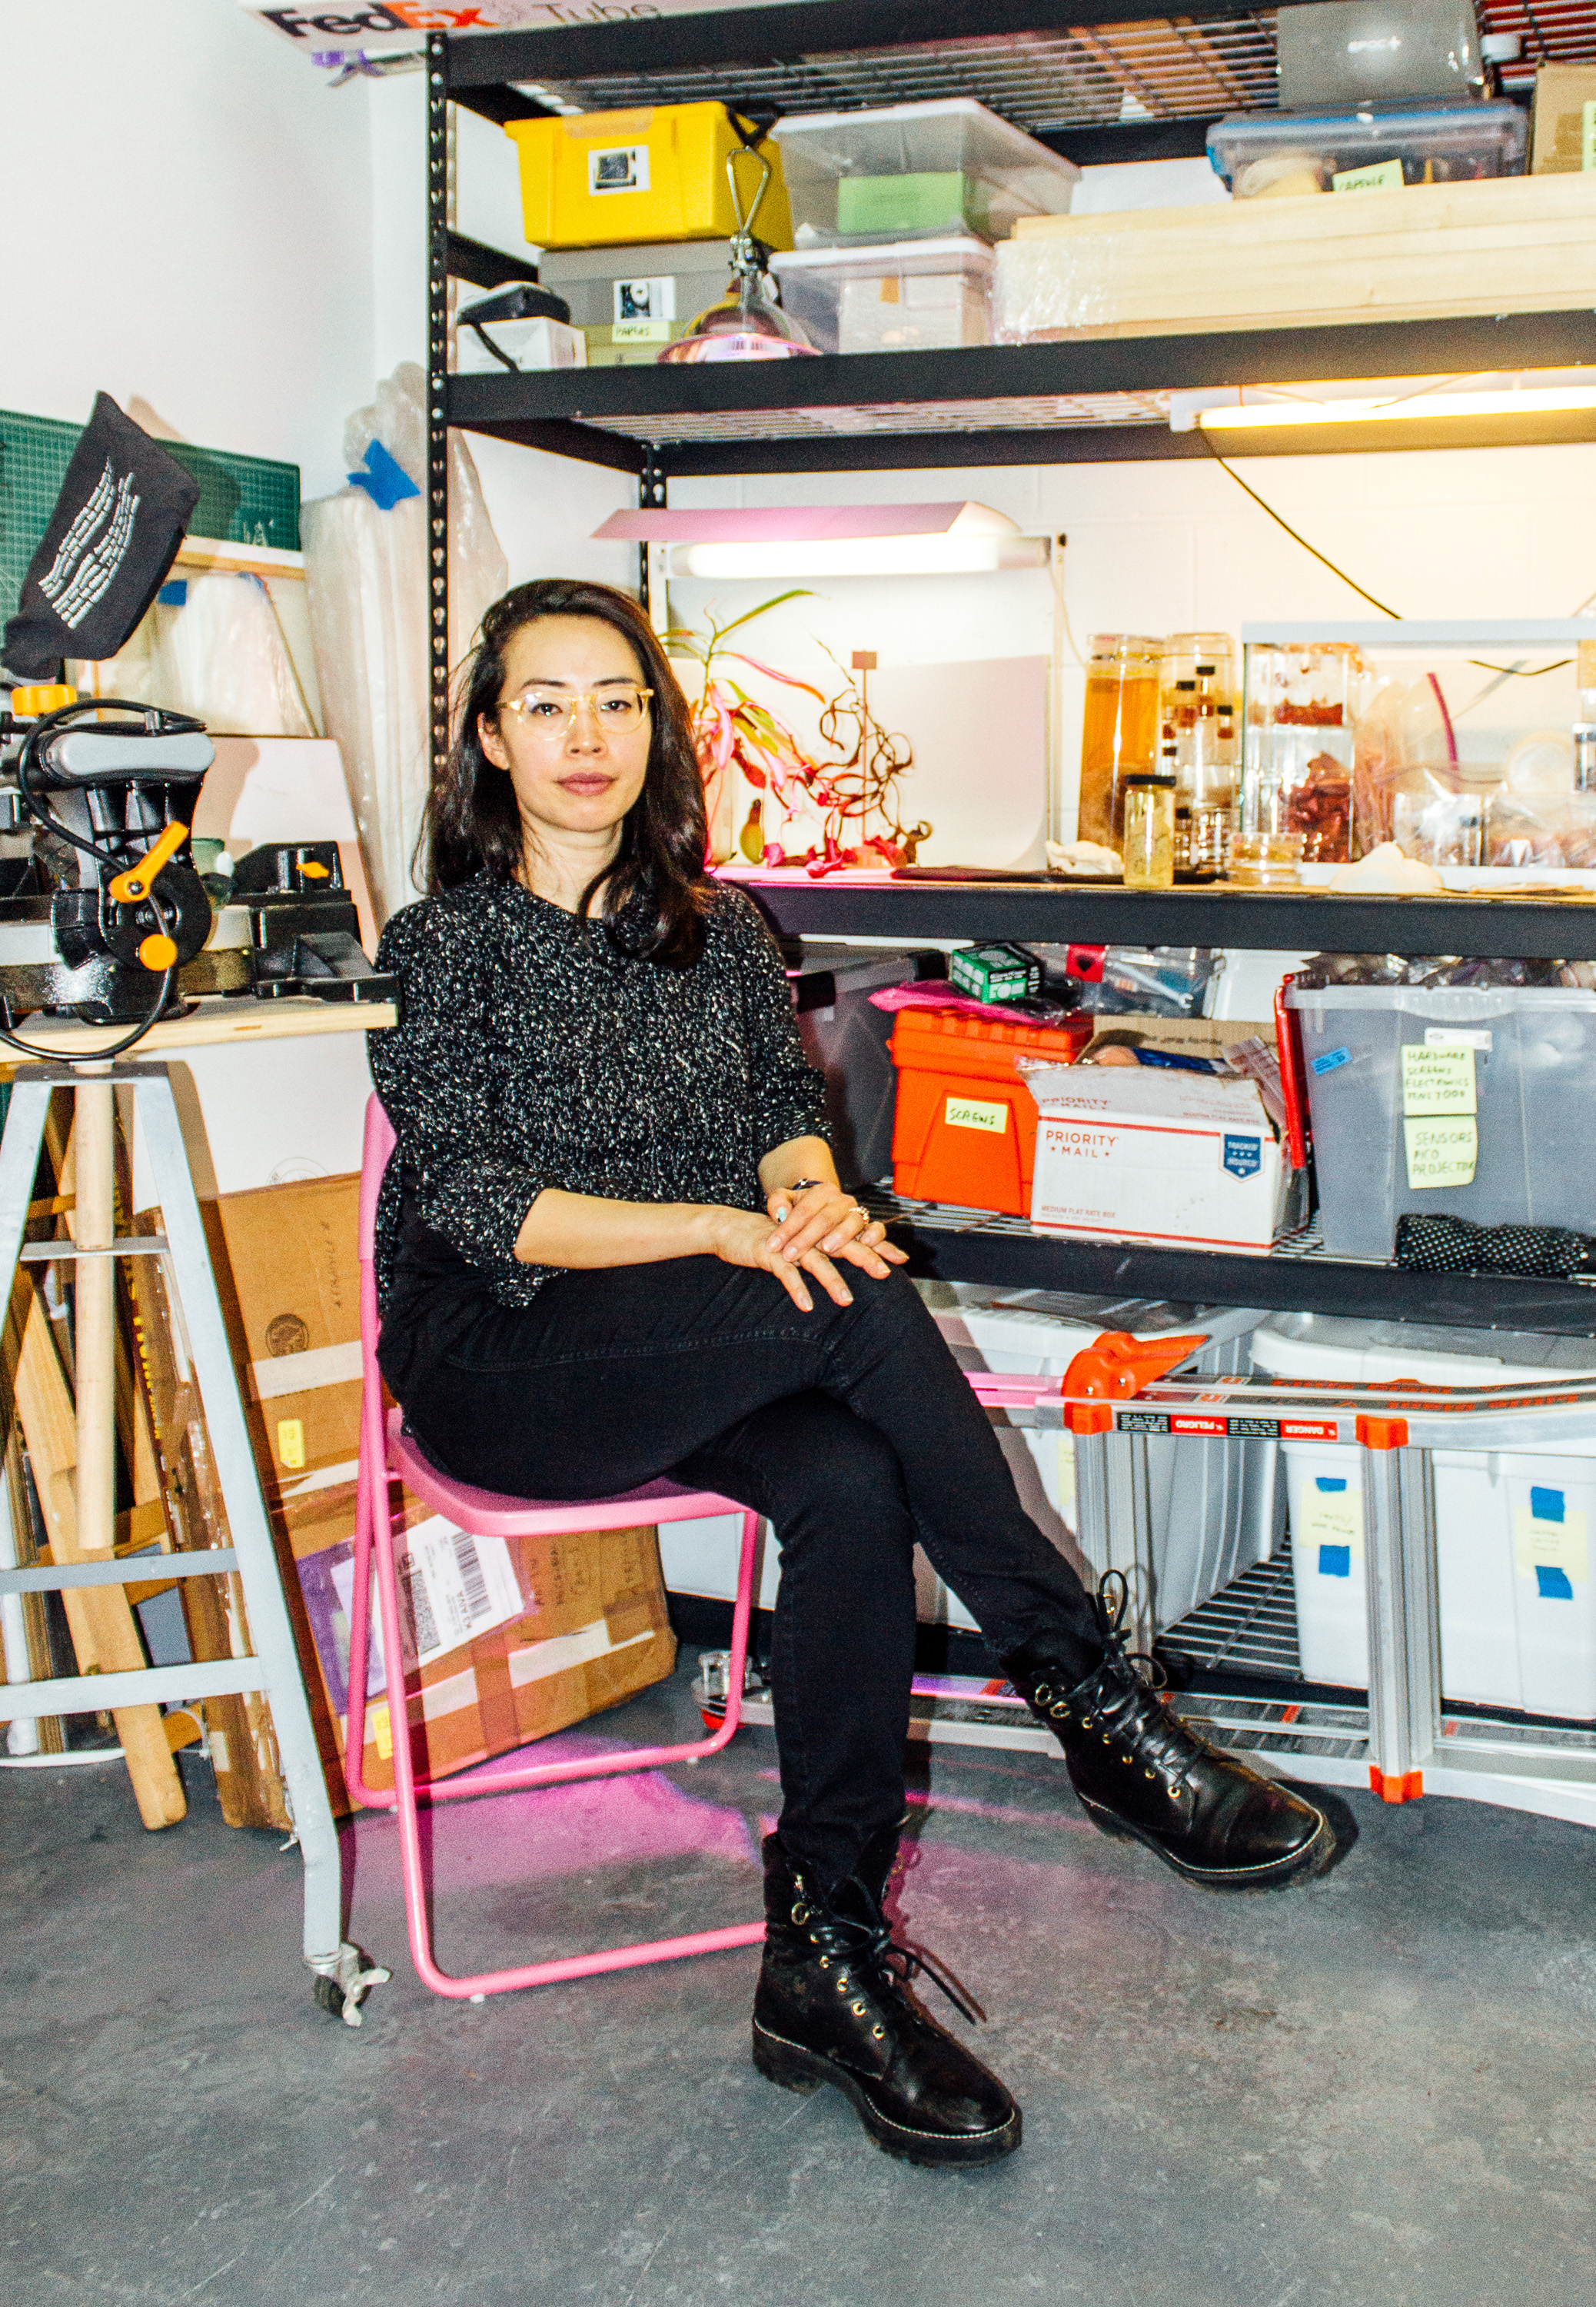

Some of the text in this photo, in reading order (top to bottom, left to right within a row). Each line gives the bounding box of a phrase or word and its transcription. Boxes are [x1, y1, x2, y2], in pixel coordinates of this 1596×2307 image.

[258, 1, 659, 38] FedEx Tube
[949, 1107, 996, 1125] SCREWS
[1046, 1130, 1116, 1147] PRIORITY
[1415, 1131, 1472, 1146] SENSORS
[1062, 1146, 1098, 1158] MAIL
[1413, 1148, 1439, 1161] PICO
[1175, 1420, 1215, 1430] PELIGRO
[1285, 1424, 1324, 1435] DANGER
